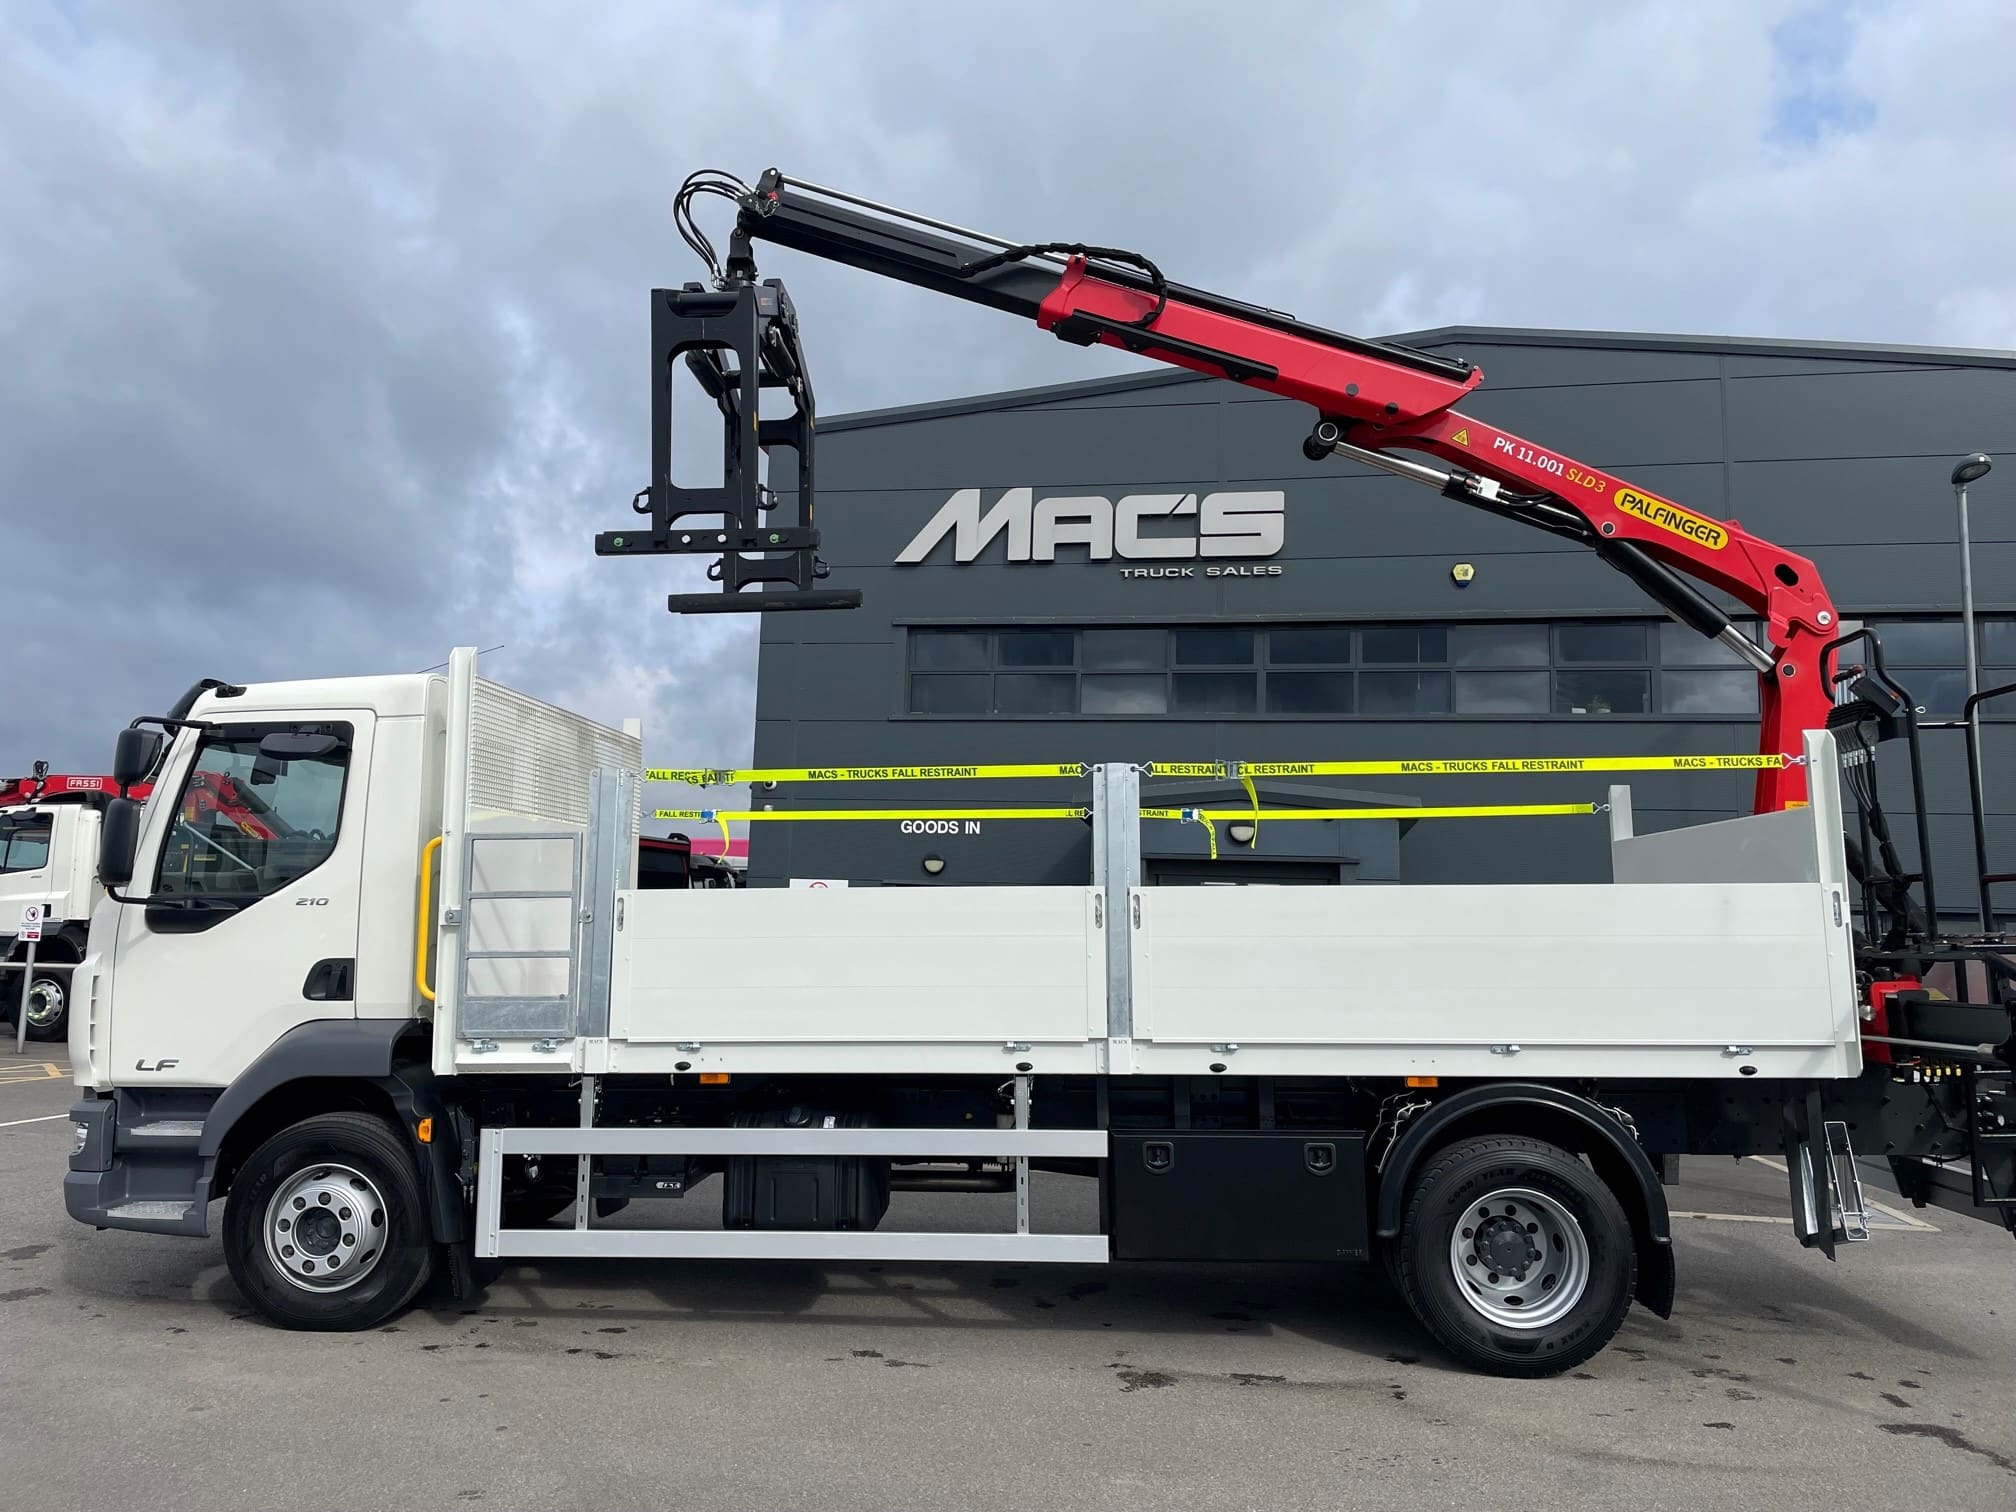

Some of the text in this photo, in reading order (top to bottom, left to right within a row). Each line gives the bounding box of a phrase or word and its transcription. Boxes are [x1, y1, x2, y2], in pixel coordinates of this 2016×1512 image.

[1493, 437, 1517, 456] PK
[1516, 447, 1566, 477] 11.001
[1619, 492, 1722, 546] PALFINGER
[1119, 565, 1283, 579] TRUCK SALES
[1400, 762, 1433, 772] MACS
[1442, 761, 1488, 771] TRUCKS
[1491, 761, 1521, 771] FALL
[1521, 760, 1585, 770] RESTRAINT
[1673, 758, 1706, 767] MACS
[1716, 757, 1763, 767] TRUCKS
[807, 770, 838, 779] MACS
[846, 769, 889, 779] TRUCKS
[891, 768, 918, 778] FALL
[919, 767, 978, 777] RESTRAINT
[1254, 764, 1315, 774] RESTRAINT
[70, 779, 100, 788] FASSI
[659, 810, 678, 818] FALL
[900, 820, 981, 835] GOODS IN
[295, 897, 330, 906] 210
[135, 1059, 180, 1071] LF
